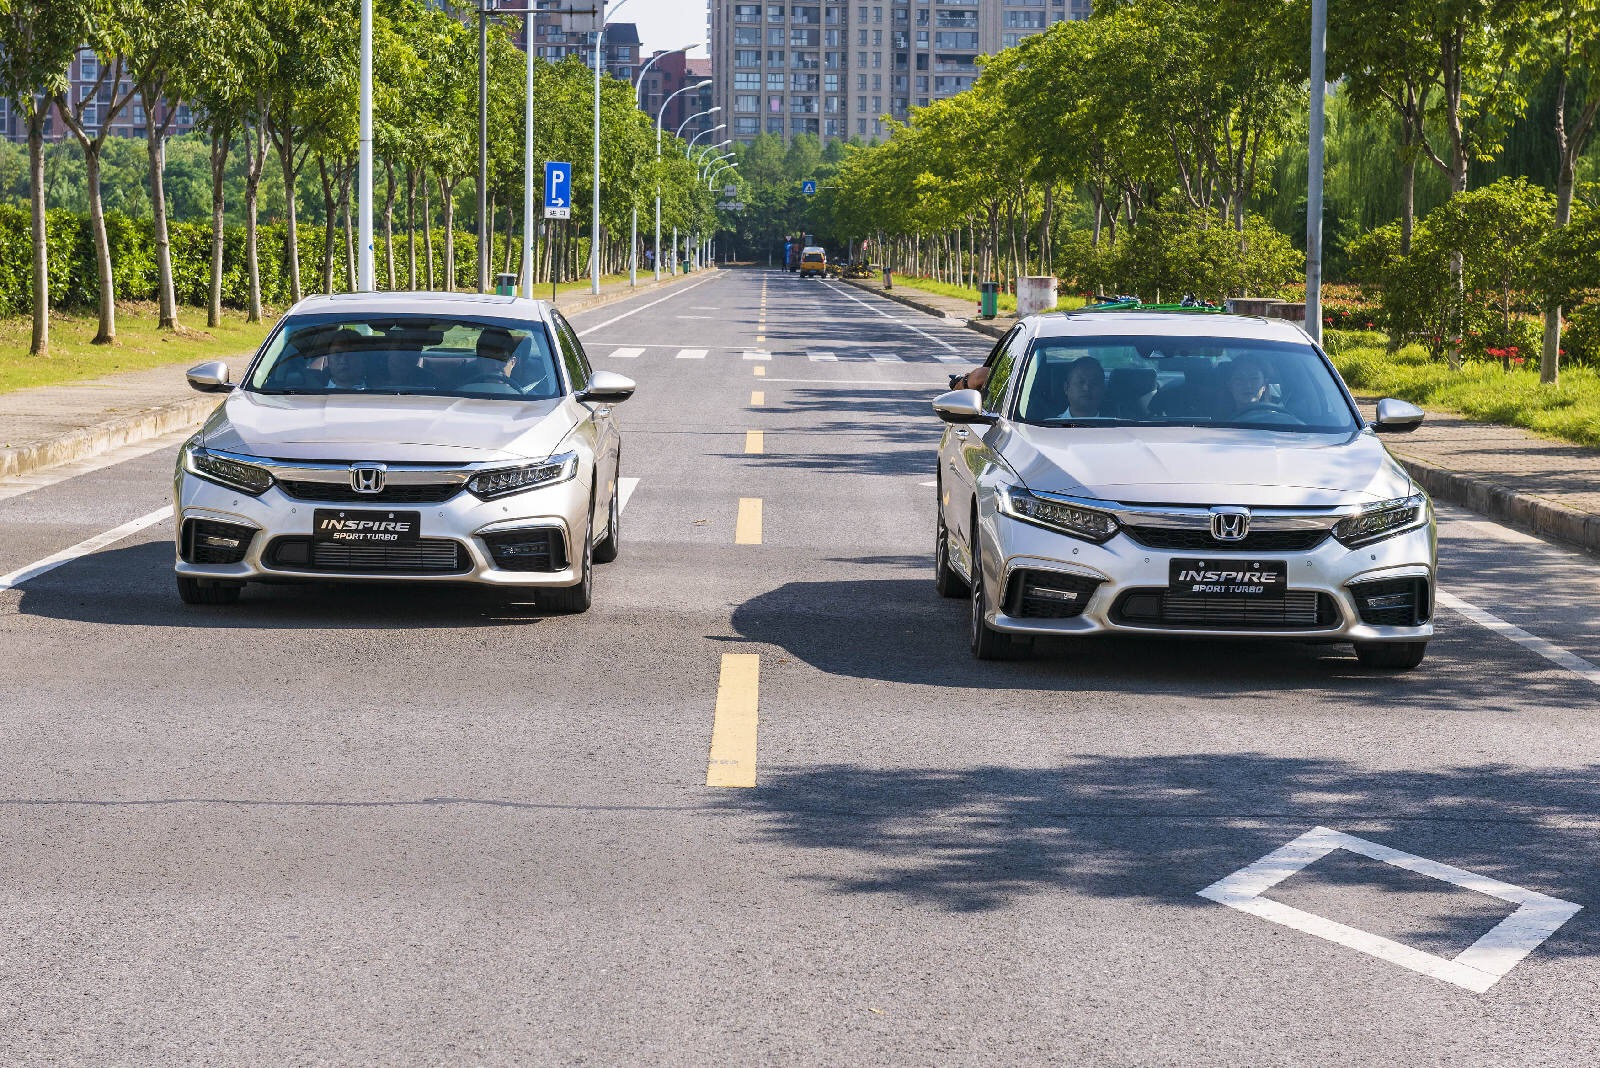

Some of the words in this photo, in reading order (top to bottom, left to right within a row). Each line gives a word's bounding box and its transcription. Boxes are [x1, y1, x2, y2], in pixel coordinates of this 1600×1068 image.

[552, 170, 565, 199] P
[321, 519, 411, 532] INSPIRE
[333, 532, 365, 540] SPORT
[366, 533, 399, 541] TURBO
[1178, 570, 1278, 583] INSPIRE
[1192, 584, 1228, 593] SPORT
[1228, 585, 1264, 593] TURBO
